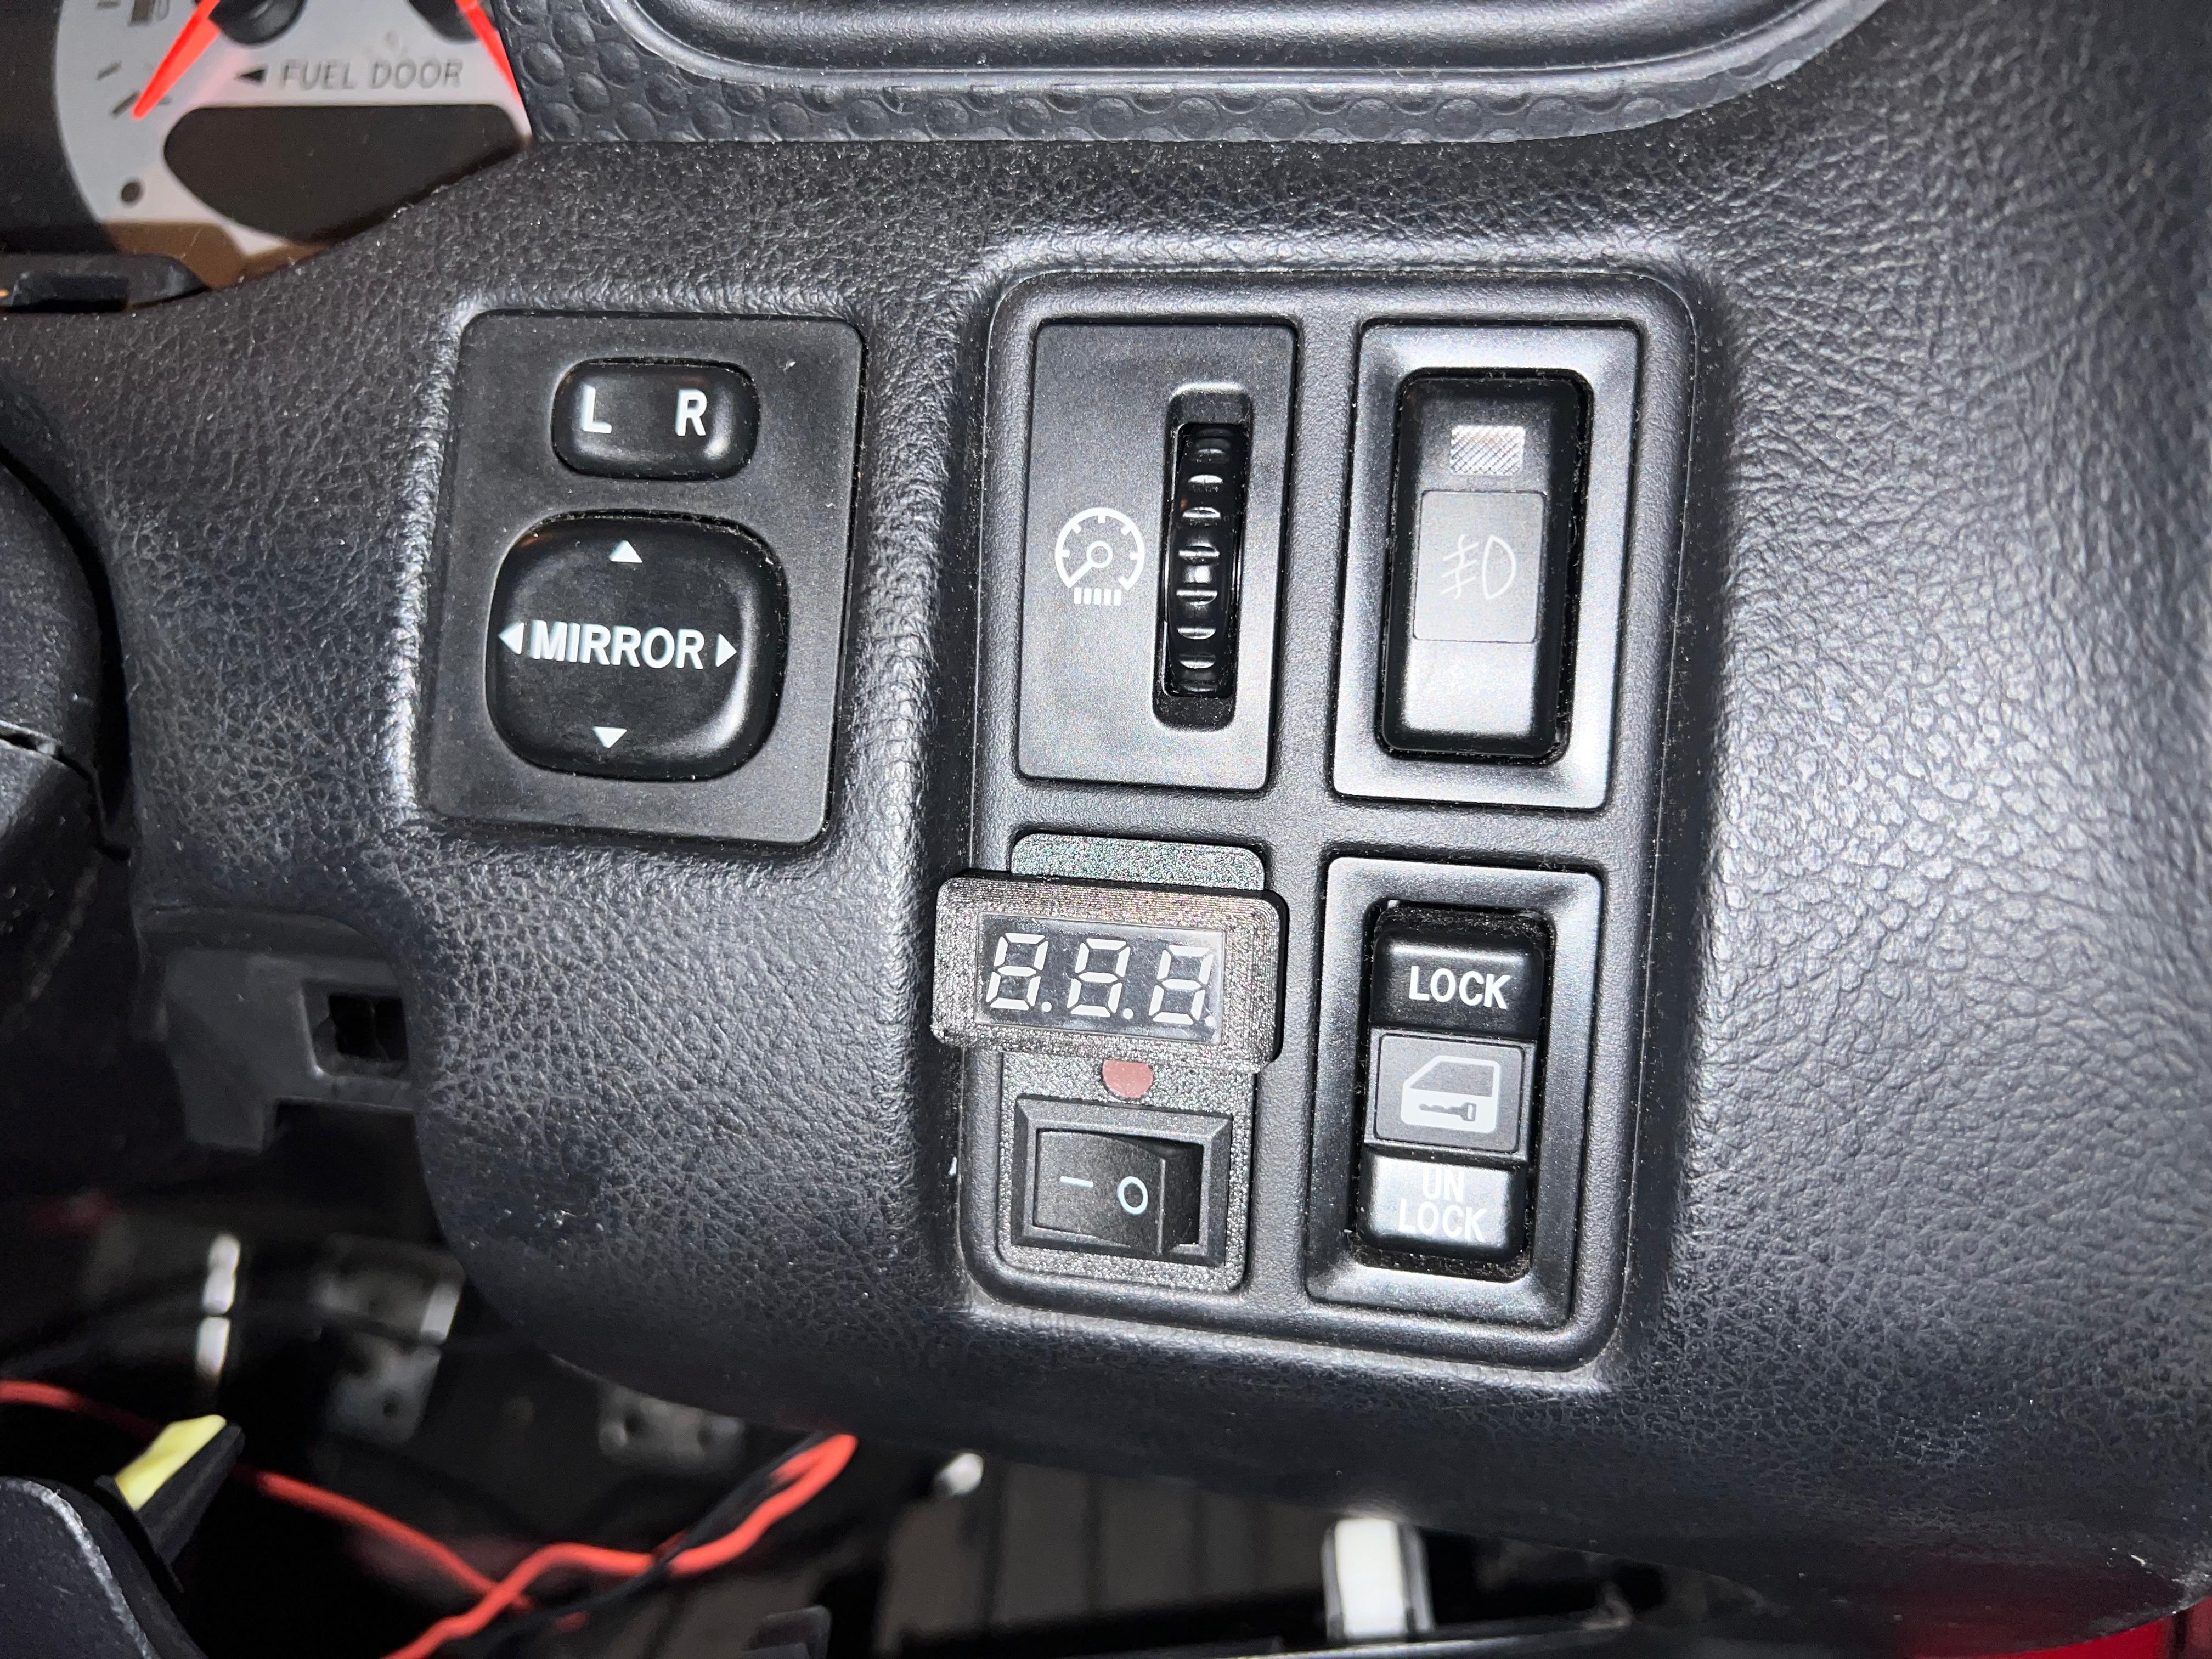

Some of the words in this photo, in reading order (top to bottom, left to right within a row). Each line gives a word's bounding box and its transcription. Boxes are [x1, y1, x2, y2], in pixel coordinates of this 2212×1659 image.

[280, 59, 357, 90] FUEL
[370, 57, 464, 89] DOOR
[580, 384, 612, 433] L
[675, 388, 708, 437] R
[529, 619, 705, 670] MIRROR
[1408, 966, 1511, 1009] LOCK
[1423, 1167, 1465, 1203] UN
[1398, 1198, 1486, 1243] LOCK
